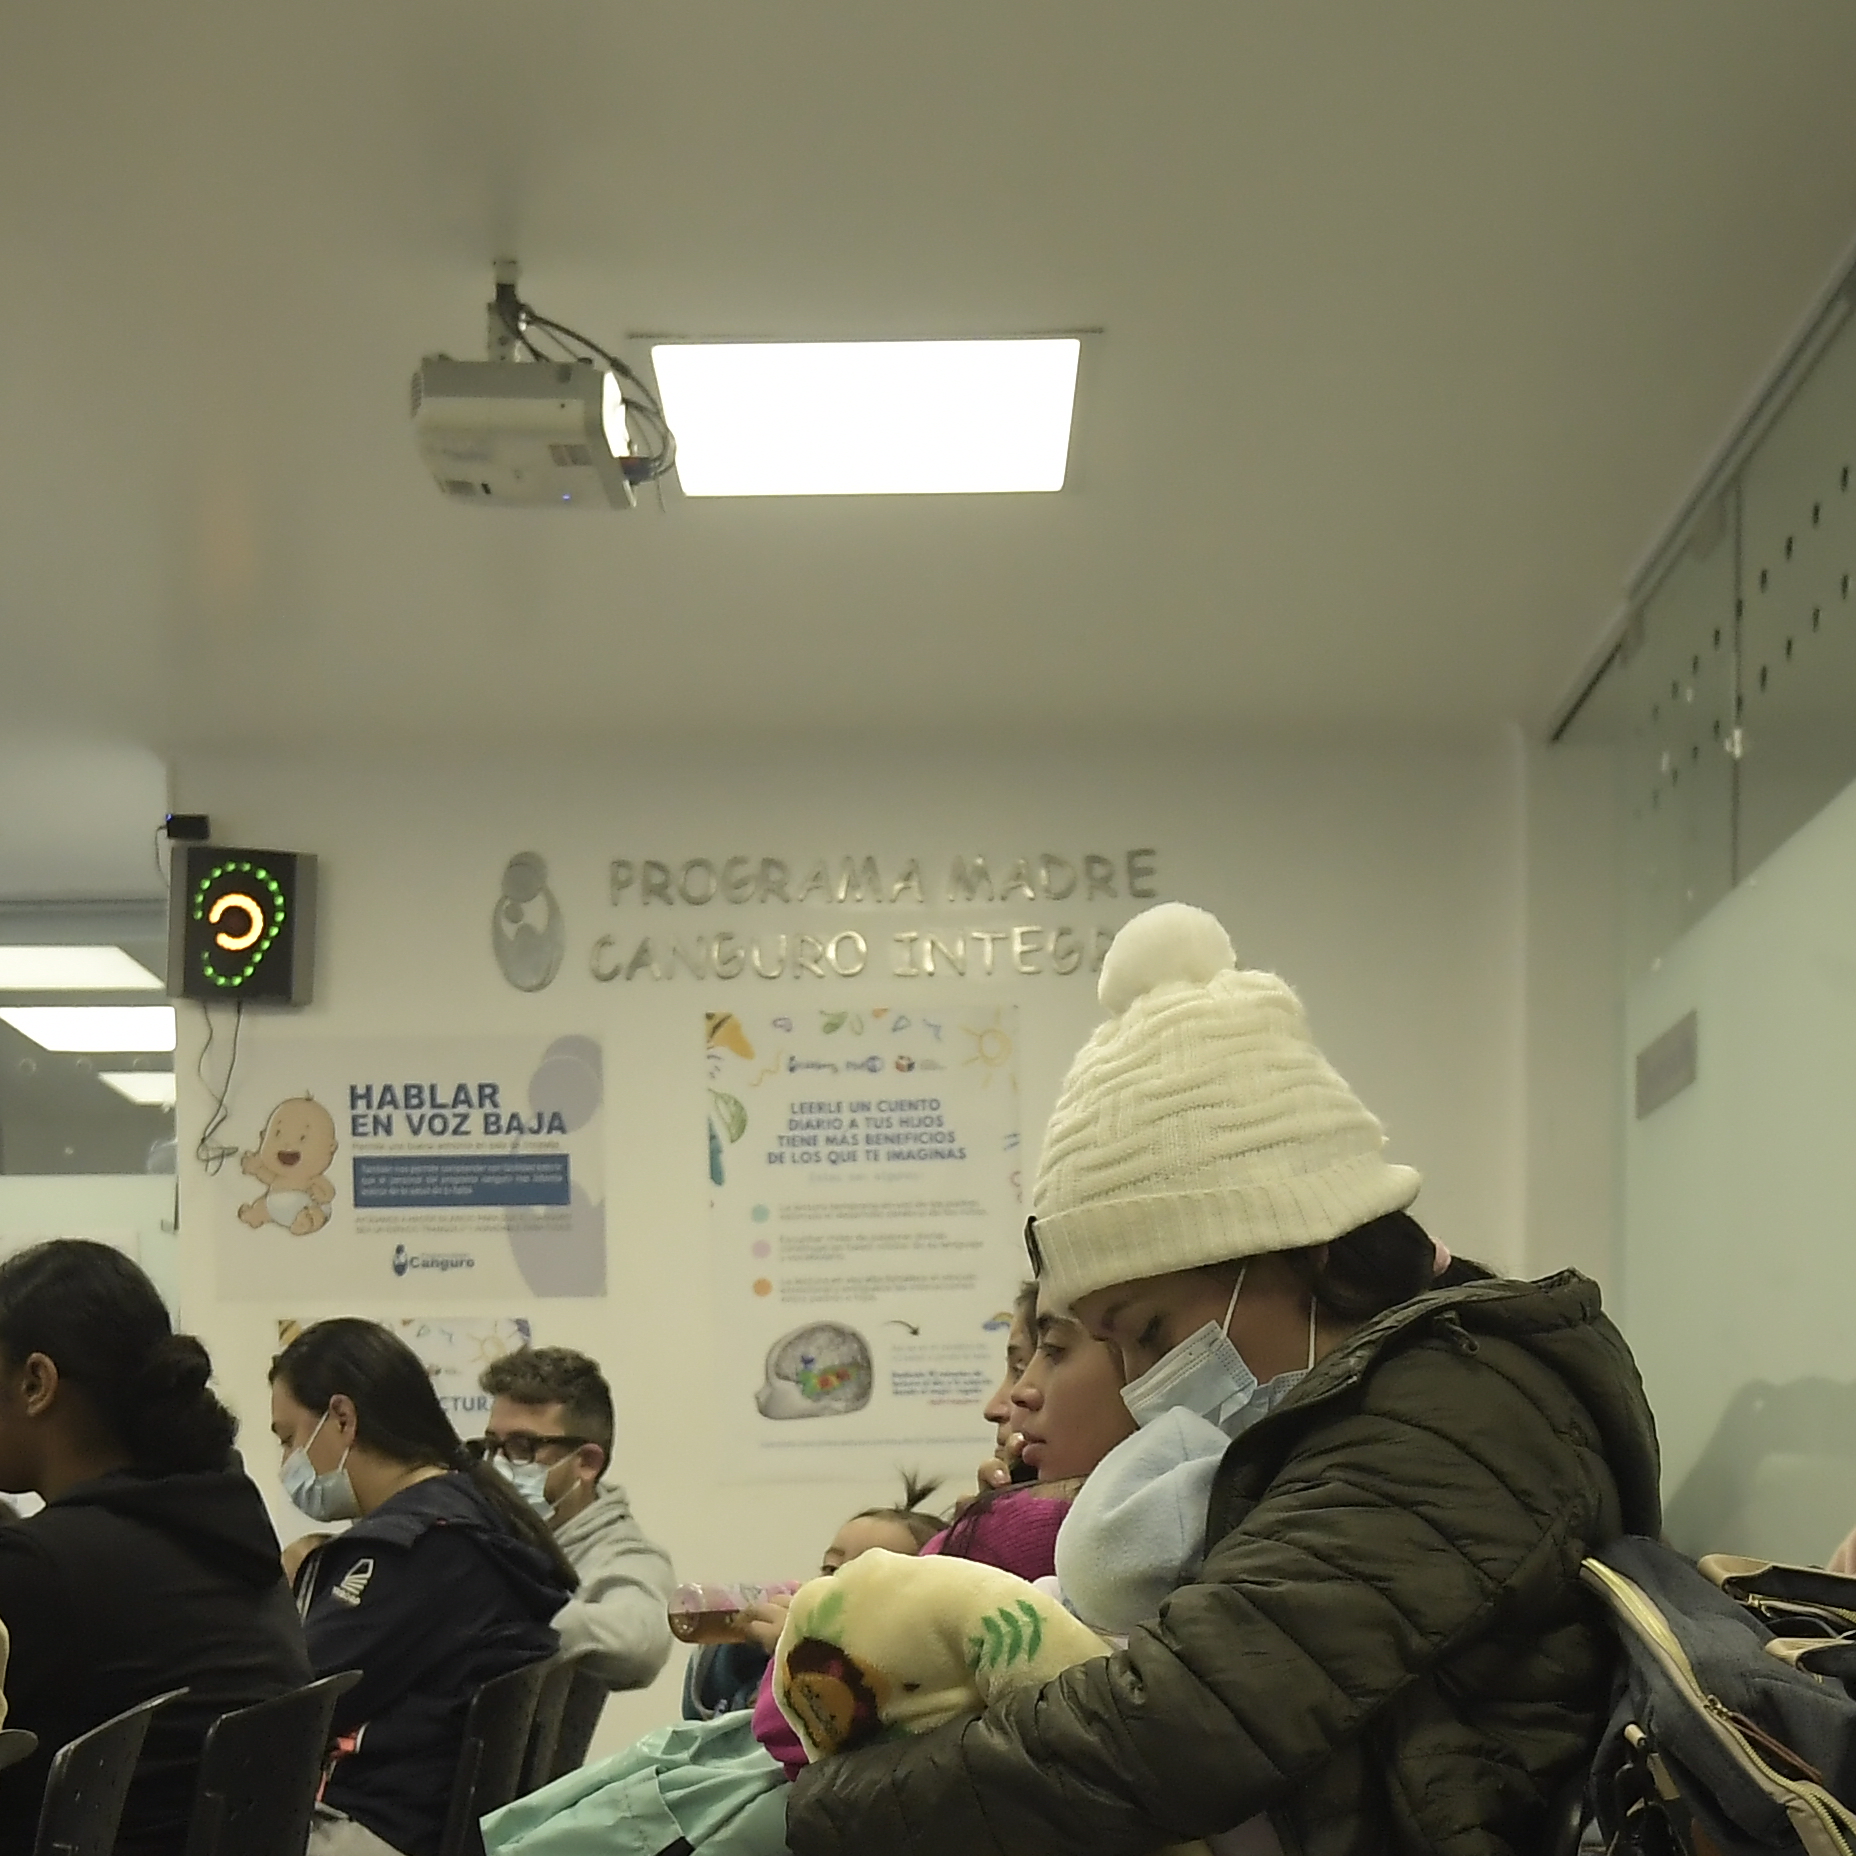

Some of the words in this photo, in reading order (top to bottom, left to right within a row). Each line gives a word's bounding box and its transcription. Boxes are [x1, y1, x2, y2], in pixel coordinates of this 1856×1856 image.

[609, 855, 925, 906] PROGRAMA
[947, 848, 1157, 903] MADRE
[589, 930, 867, 981] CANGURO
[349, 1082, 501, 1110] HABLAR
[790, 1101, 843, 1114] LEERLE
[849, 1101, 871, 1113] UN
[877, 1099, 941, 1112] CUENTO
[351, 1113, 393, 1136] EN
[406, 1113, 472, 1136] VOZ
[483, 1111, 568, 1135] BAJA
[788, 1118, 843, 1131] DIARIO
[848, 1118, 859, 1129] A
[865, 1116, 893, 1129] TUS
[899, 1115, 944, 1128] HIJOS
[778, 1135, 818, 1147] TIENE
[865, 1131, 956, 1145] BENEFICIOS
[768, 1152, 785, 1164] DE
[792, 1151, 822, 1164] LOS
[827, 1151, 857, 1165] QUE
[866, 1150, 880, 1162] TE
[887, 1148, 968, 1162] IMAGINAS
[409, 1255, 475, 1271] Canguro
